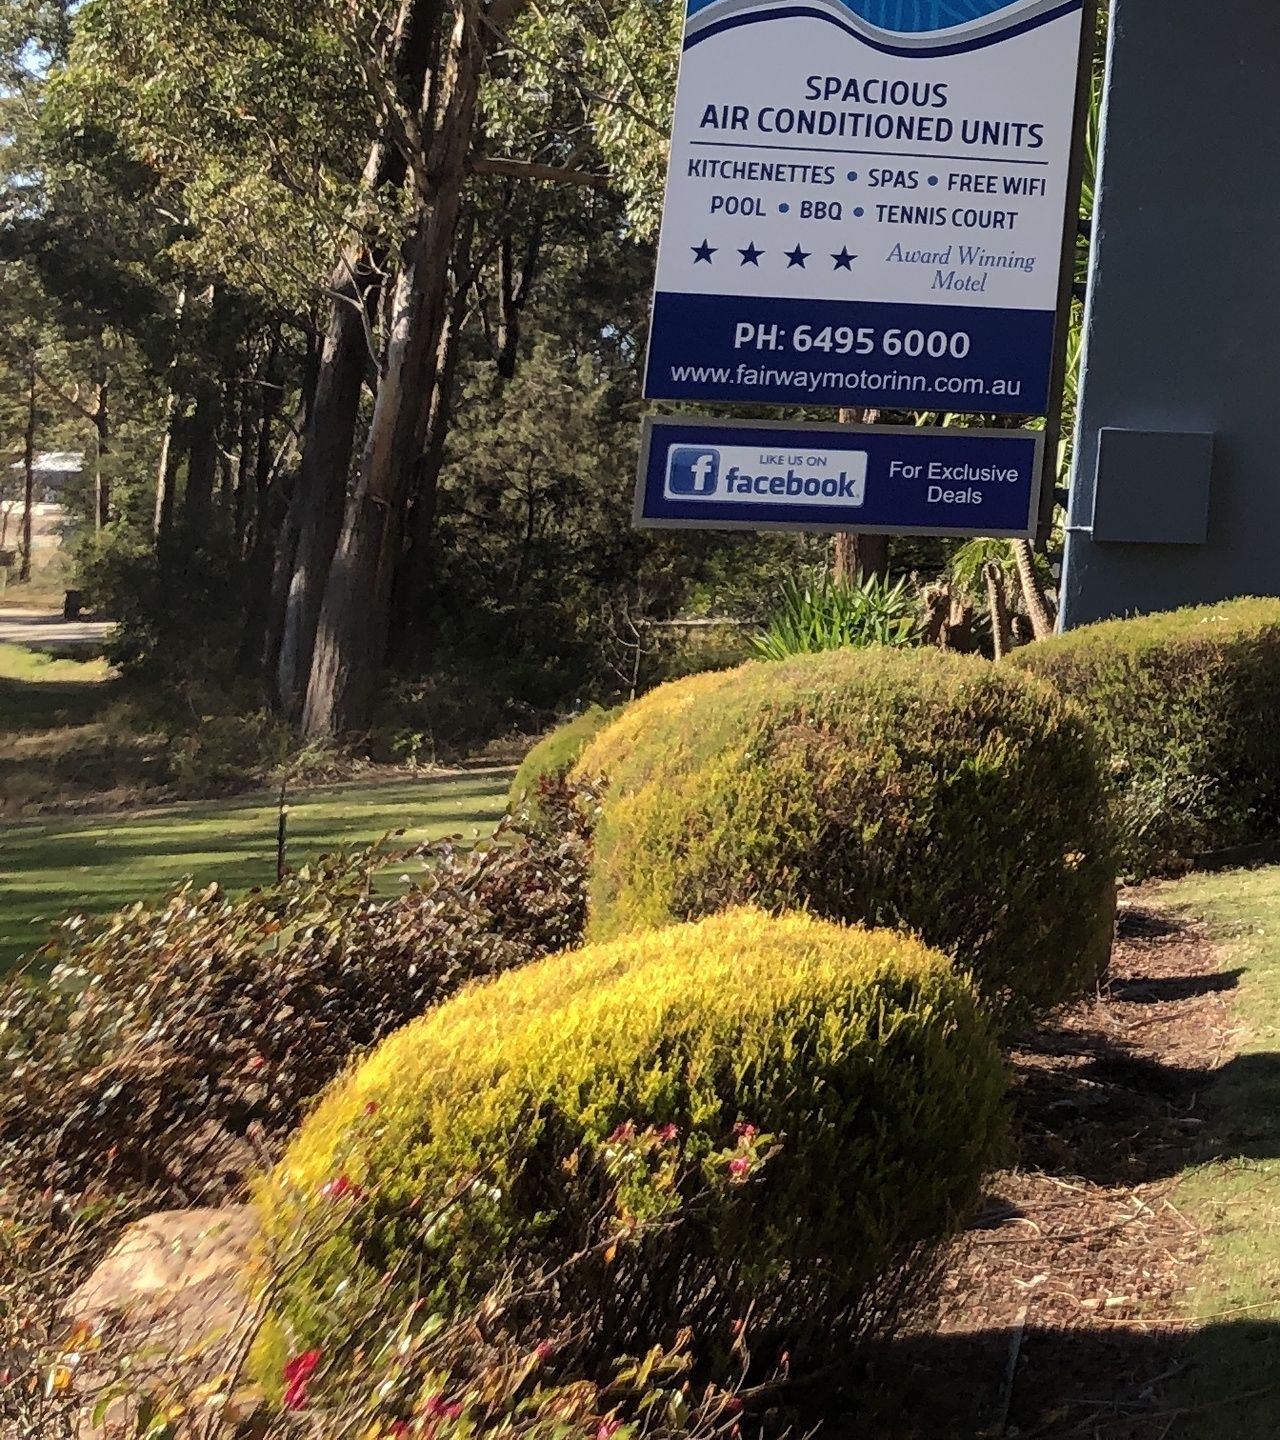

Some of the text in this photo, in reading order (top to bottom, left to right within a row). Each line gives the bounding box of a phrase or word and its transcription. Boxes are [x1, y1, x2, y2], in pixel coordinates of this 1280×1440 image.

[805, 75, 949, 108] SPACIOUS
[700, 104, 1044, 148] AIR CONDITIONED UNITS
[687, 159, 1047, 197] KITCHENETTES SPAS FREE WIFI
[710, 195, 1018, 230] POOL BBQ TENNIS COURT
[885, 243, 1036, 272] Award Winning
[930, 269, 986, 293] Motel
[734, 322, 971, 359] PH: 6495 6000
[670, 363, 1022, 397] www.fairwaymotorinn.com.au
[759, 454, 828, 467] LIKE US ON
[889, 461, 1019, 483] For Exclusive
[725, 467, 856, 498] facebook
[927, 486, 983, 505] Deals
